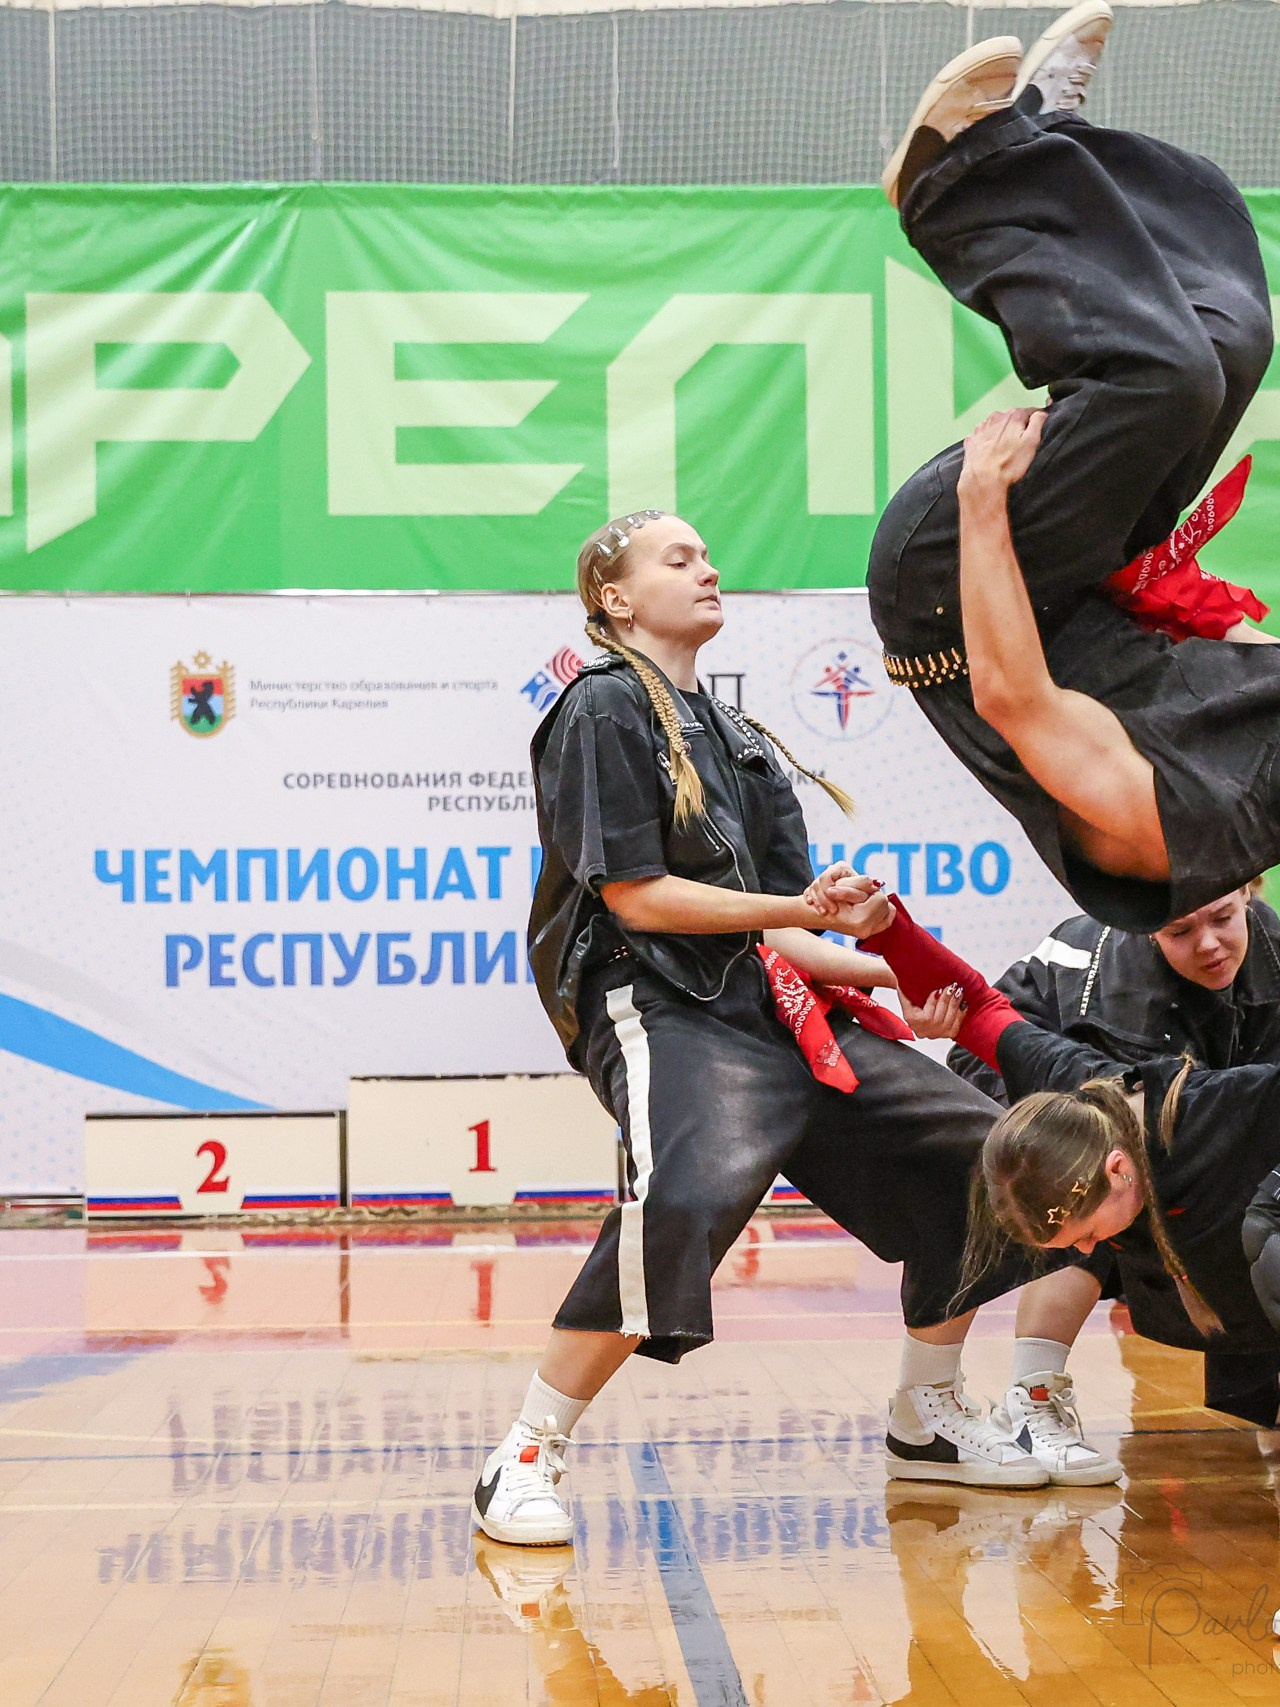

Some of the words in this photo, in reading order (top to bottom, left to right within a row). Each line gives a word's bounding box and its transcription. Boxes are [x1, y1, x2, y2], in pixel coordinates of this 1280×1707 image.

[284, 771, 463, 789] СОРЕВНОВАНИЯ
[468, 771, 534, 790] ФЕДЕ
[94, 847, 511, 903] ЧЕМПИОНАТ
[165, 931, 537, 987] РЕСПУБЛИ
[196, 1139, 230, 1194] 2
[468, 1119, 498, 1173] 1
